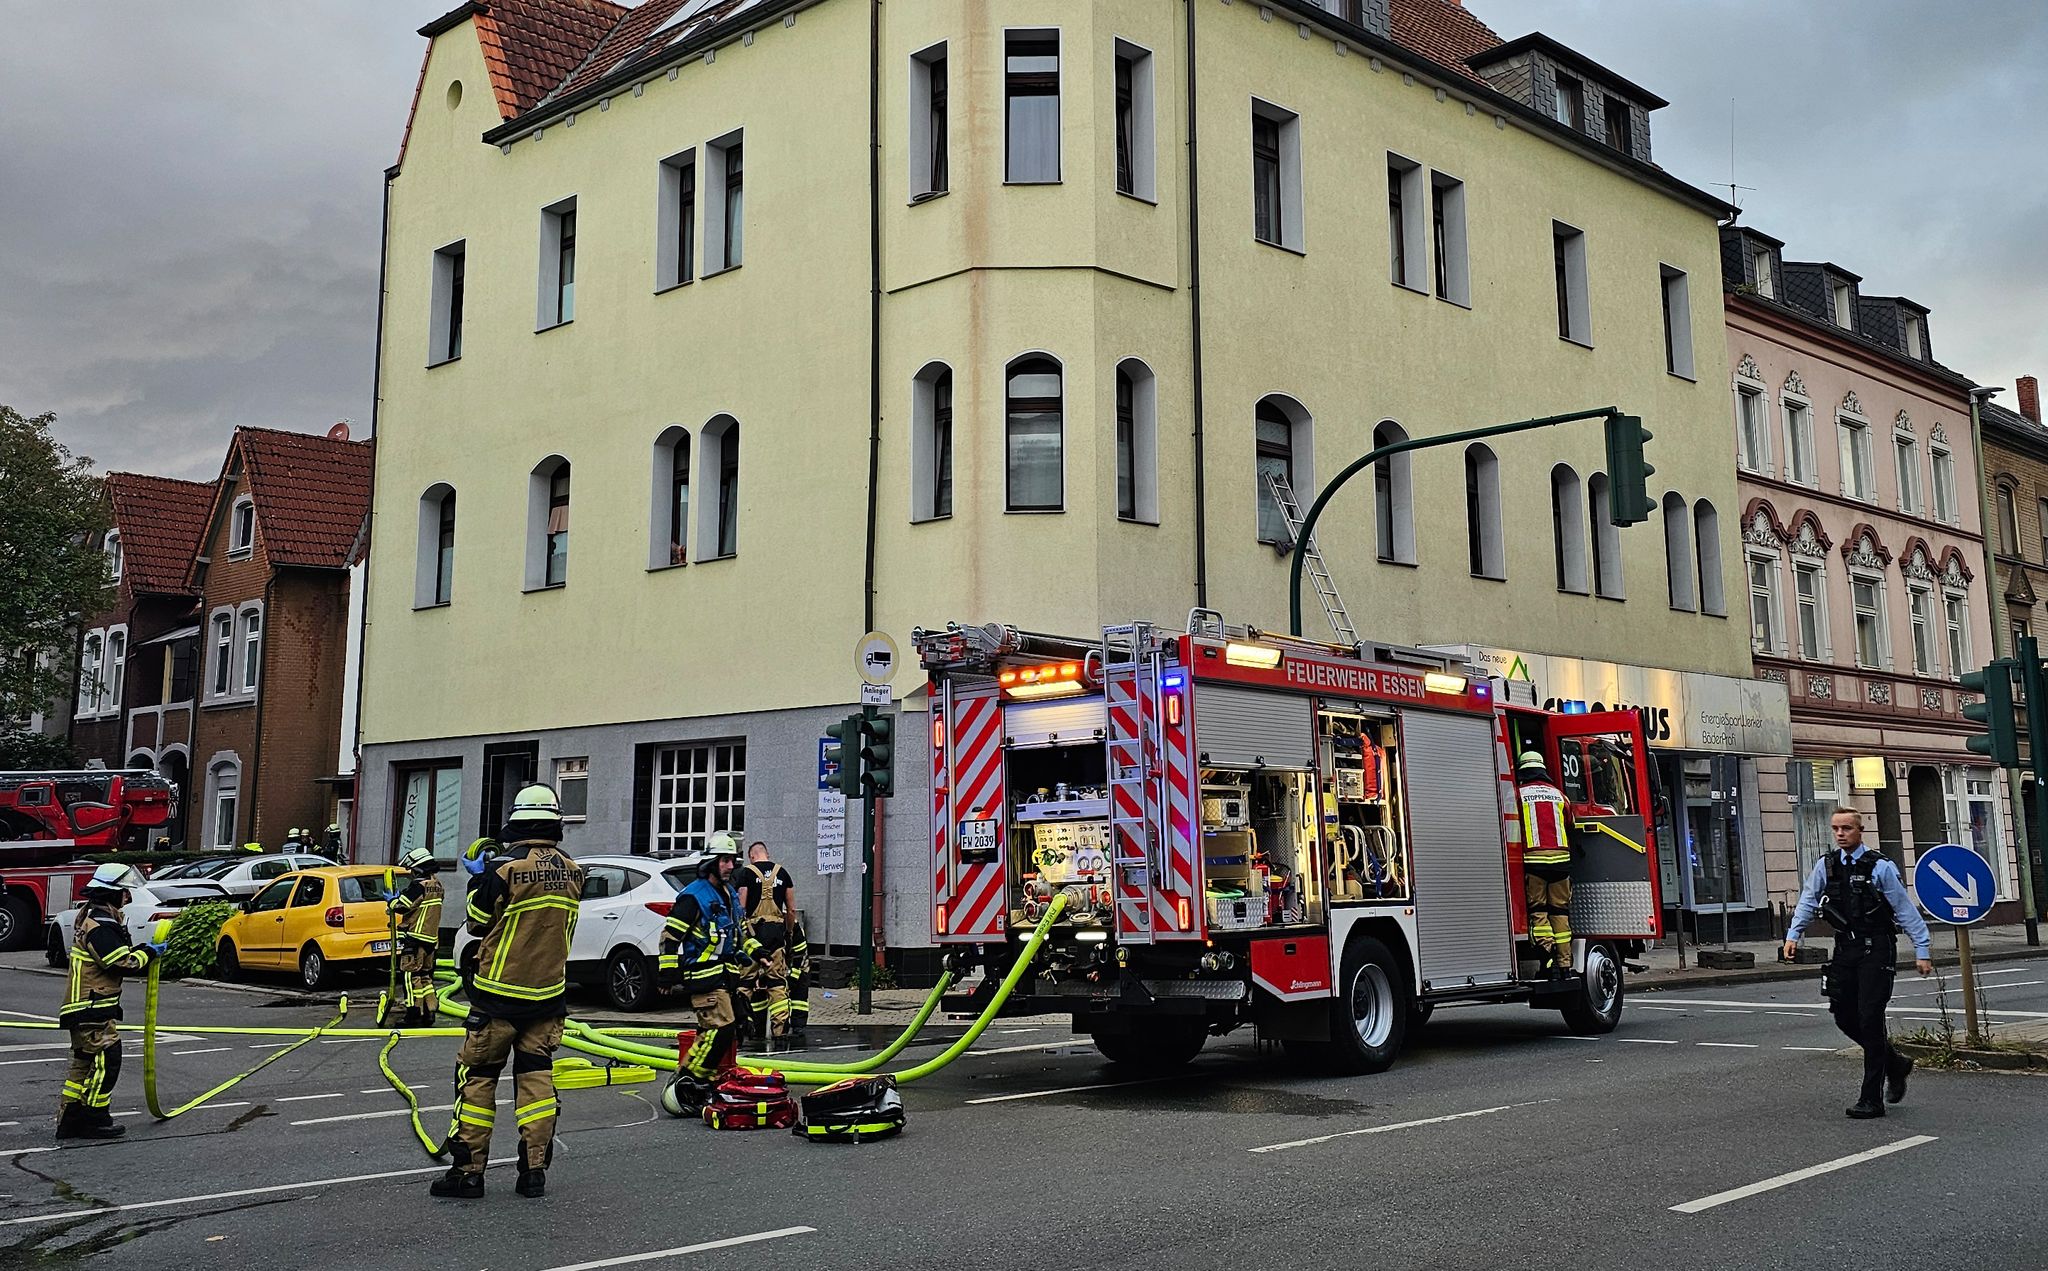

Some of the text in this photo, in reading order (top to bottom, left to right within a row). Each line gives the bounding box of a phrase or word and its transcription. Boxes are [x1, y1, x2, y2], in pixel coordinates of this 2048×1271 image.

[1479, 651, 1507, 664] Das neue
[1286, 660, 1425, 698] FEUERWEHR ESSEN
[974, 822, 980, 834] E
[974, 836, 994, 847] 2039
[820, 848, 841, 857] frei bis
[817, 863, 844, 872] Uferweg
[513, 868, 581, 885] FEUERWEHR
